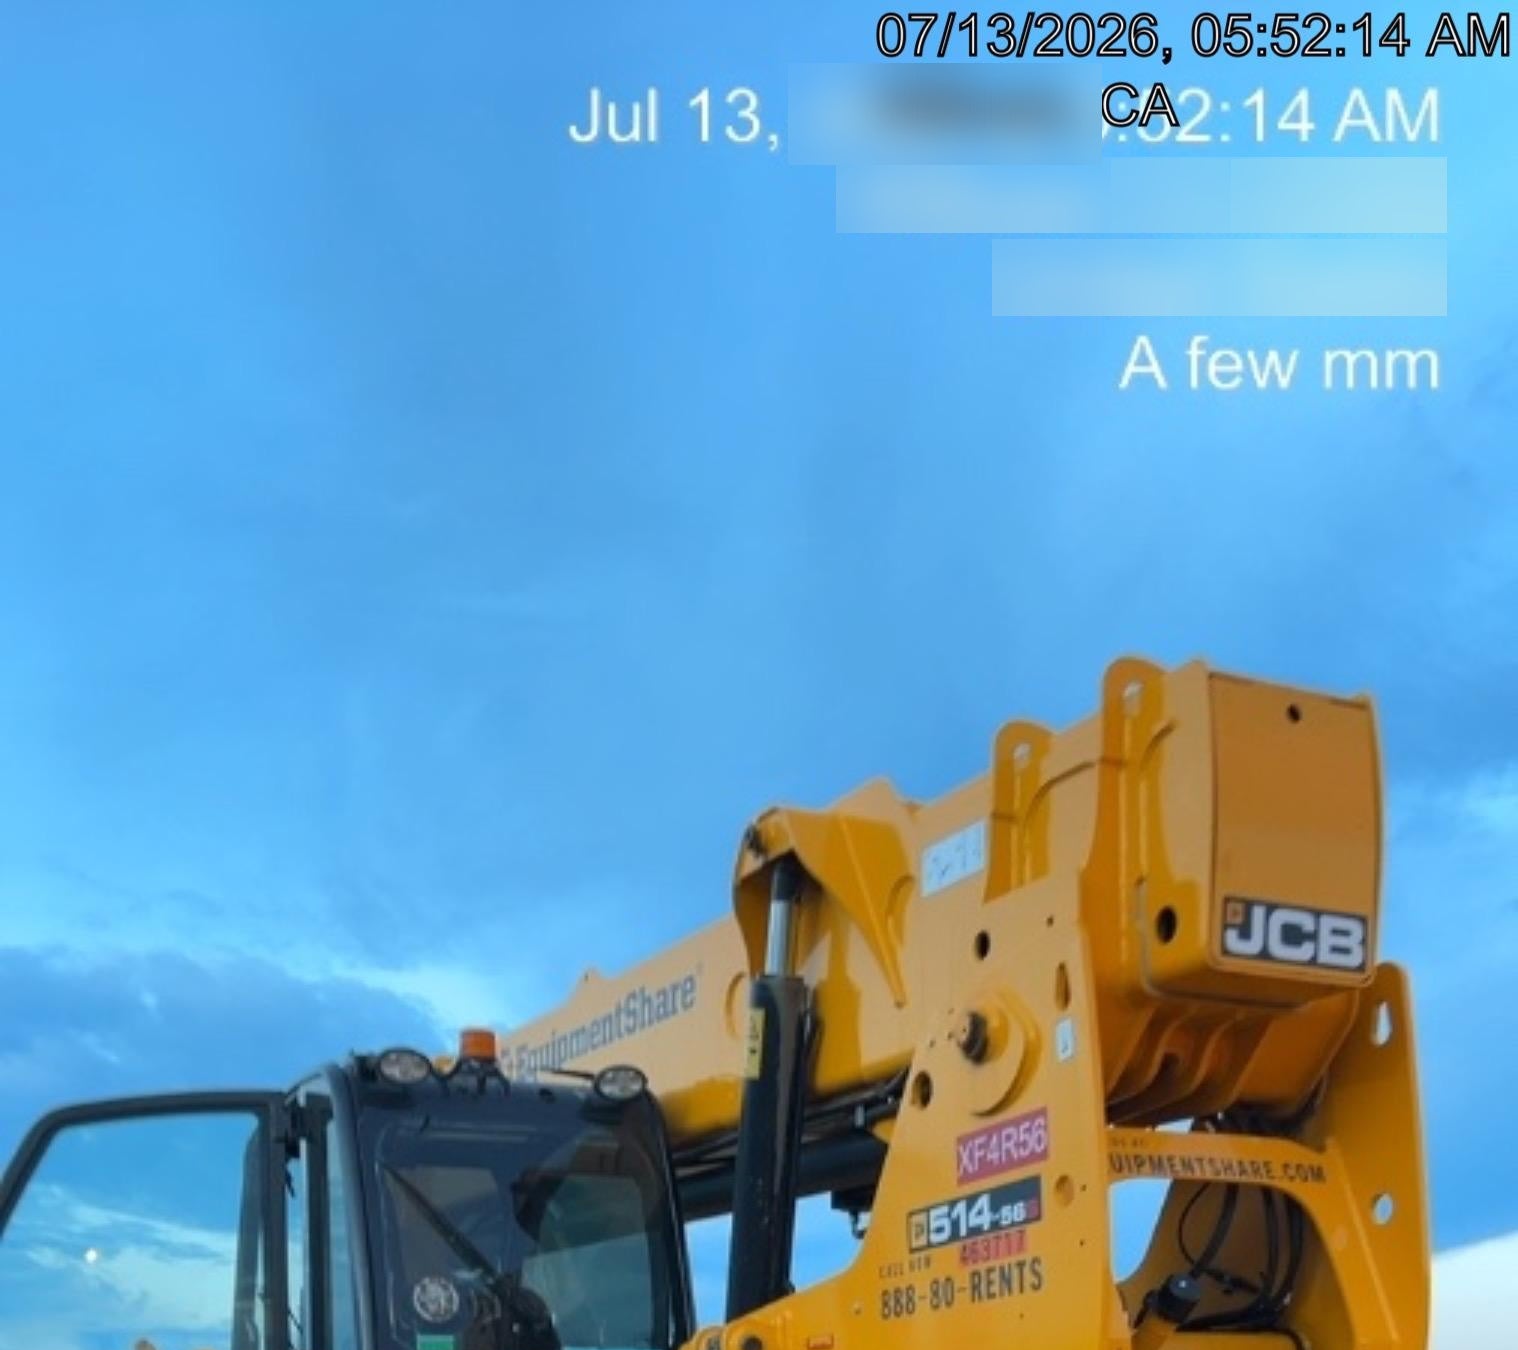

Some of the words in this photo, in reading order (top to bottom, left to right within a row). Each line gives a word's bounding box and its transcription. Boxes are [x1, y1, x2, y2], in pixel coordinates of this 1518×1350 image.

[1223, 904, 1365, 969] JCB
[517, 974, 697, 1081] EquipmentShare
[958, 1117, 1046, 1175] XF4R56
[1107, 1152, 1327, 1183] UIPMENTSHARE.COM
[880, 1256, 1043, 1320] 888-80-RENTS
